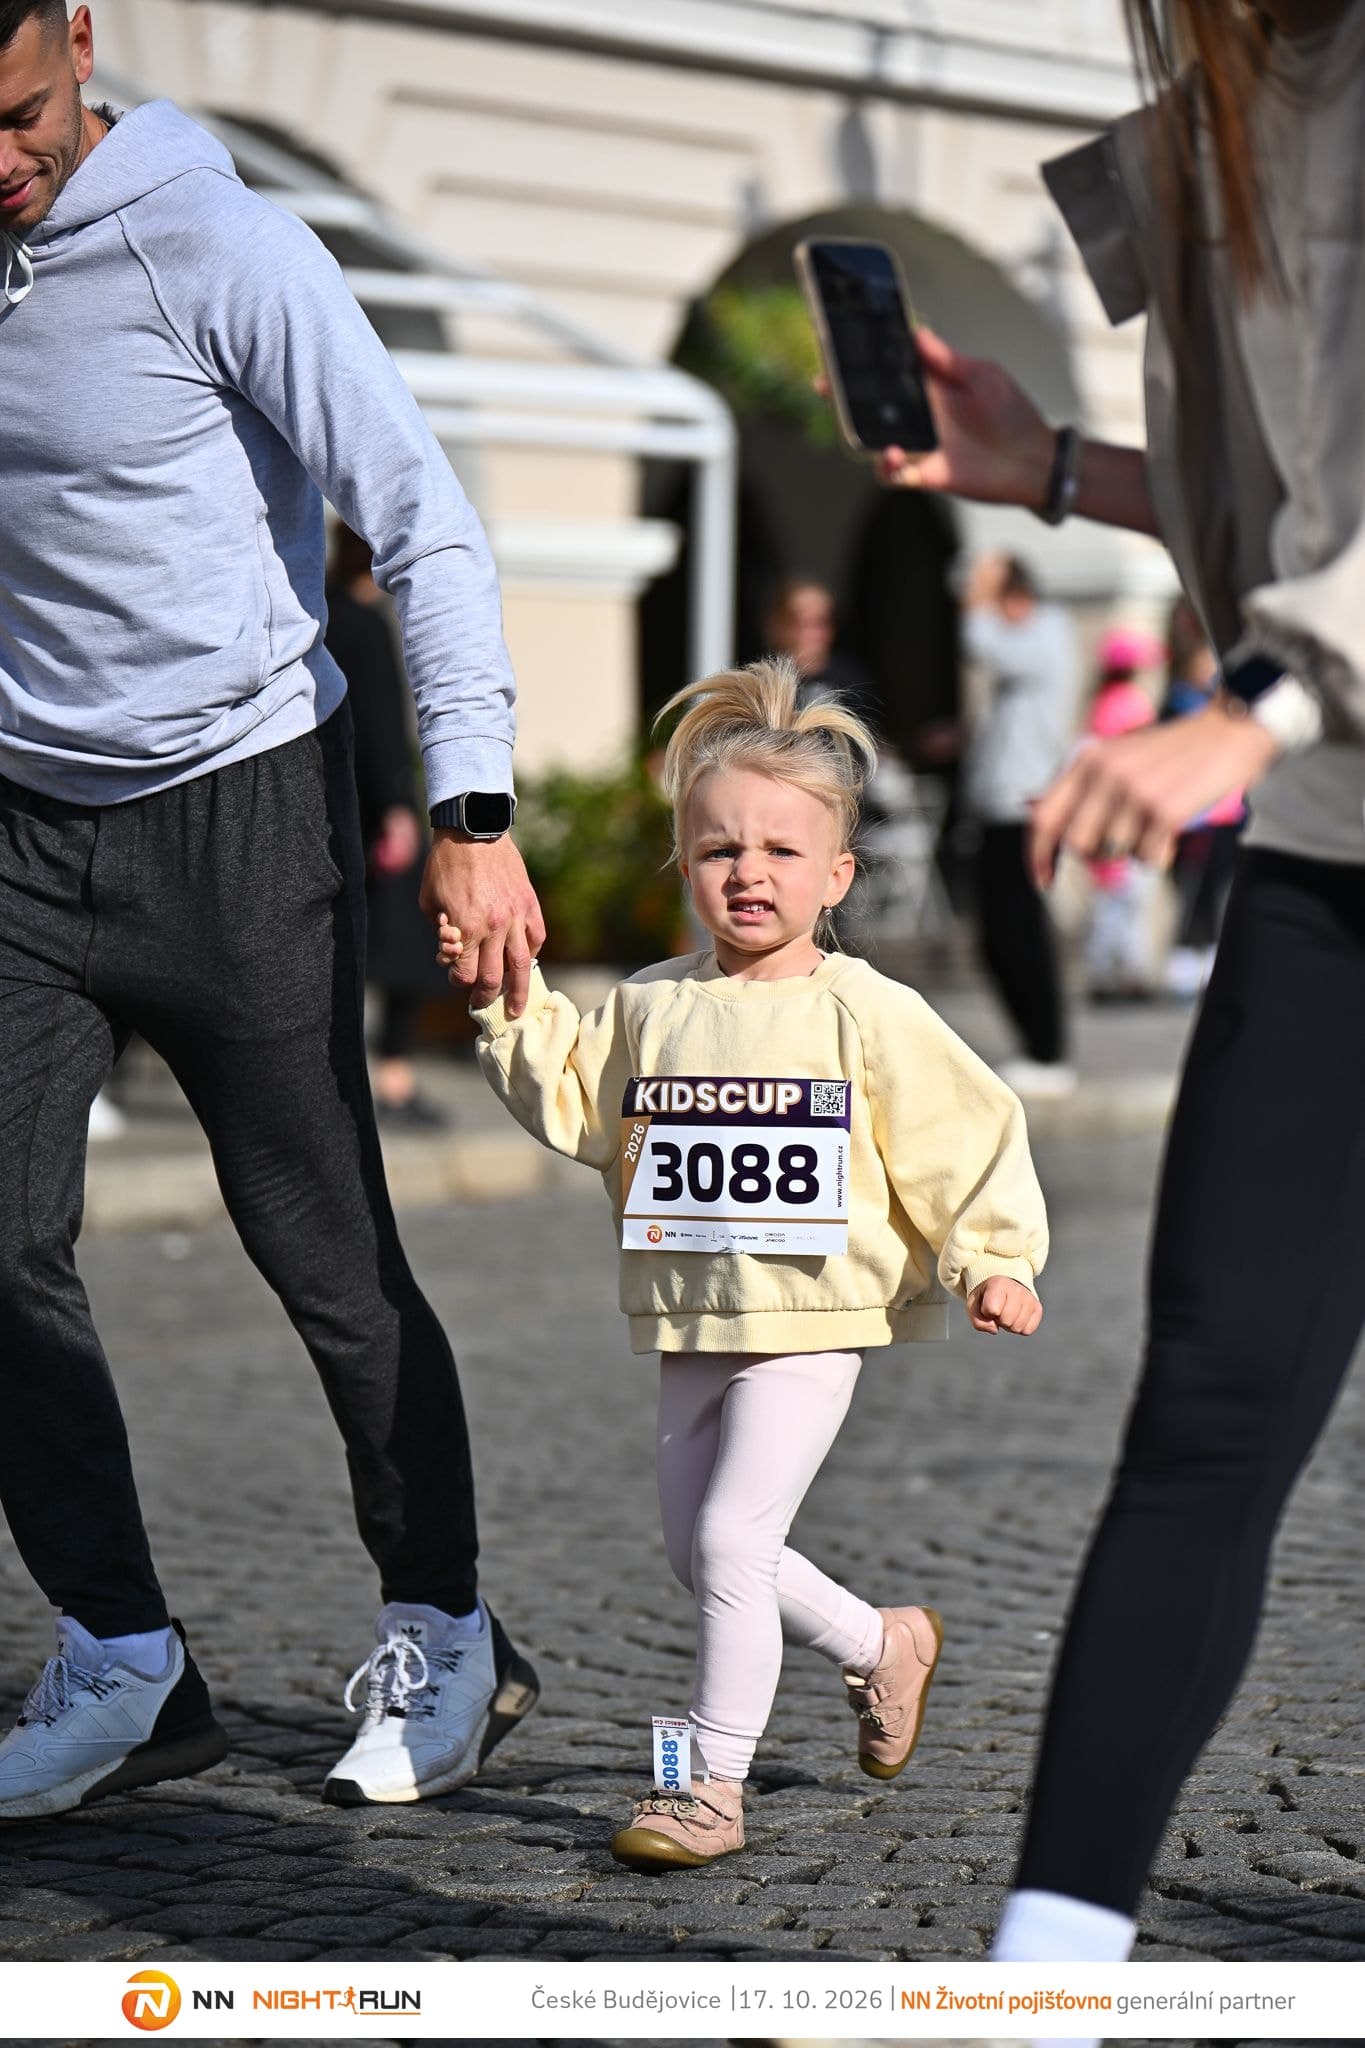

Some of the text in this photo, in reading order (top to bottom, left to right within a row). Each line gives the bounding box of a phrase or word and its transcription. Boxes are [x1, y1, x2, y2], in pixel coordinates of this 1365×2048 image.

[634, 1080, 803, 1115] KIDSCUP
[624, 1123, 646, 1163] 2026
[651, 1141, 820, 1205] 3088
[836, 1145, 844, 1208] www.nightrun.cz
[661, 1740, 680, 1789] 3088
